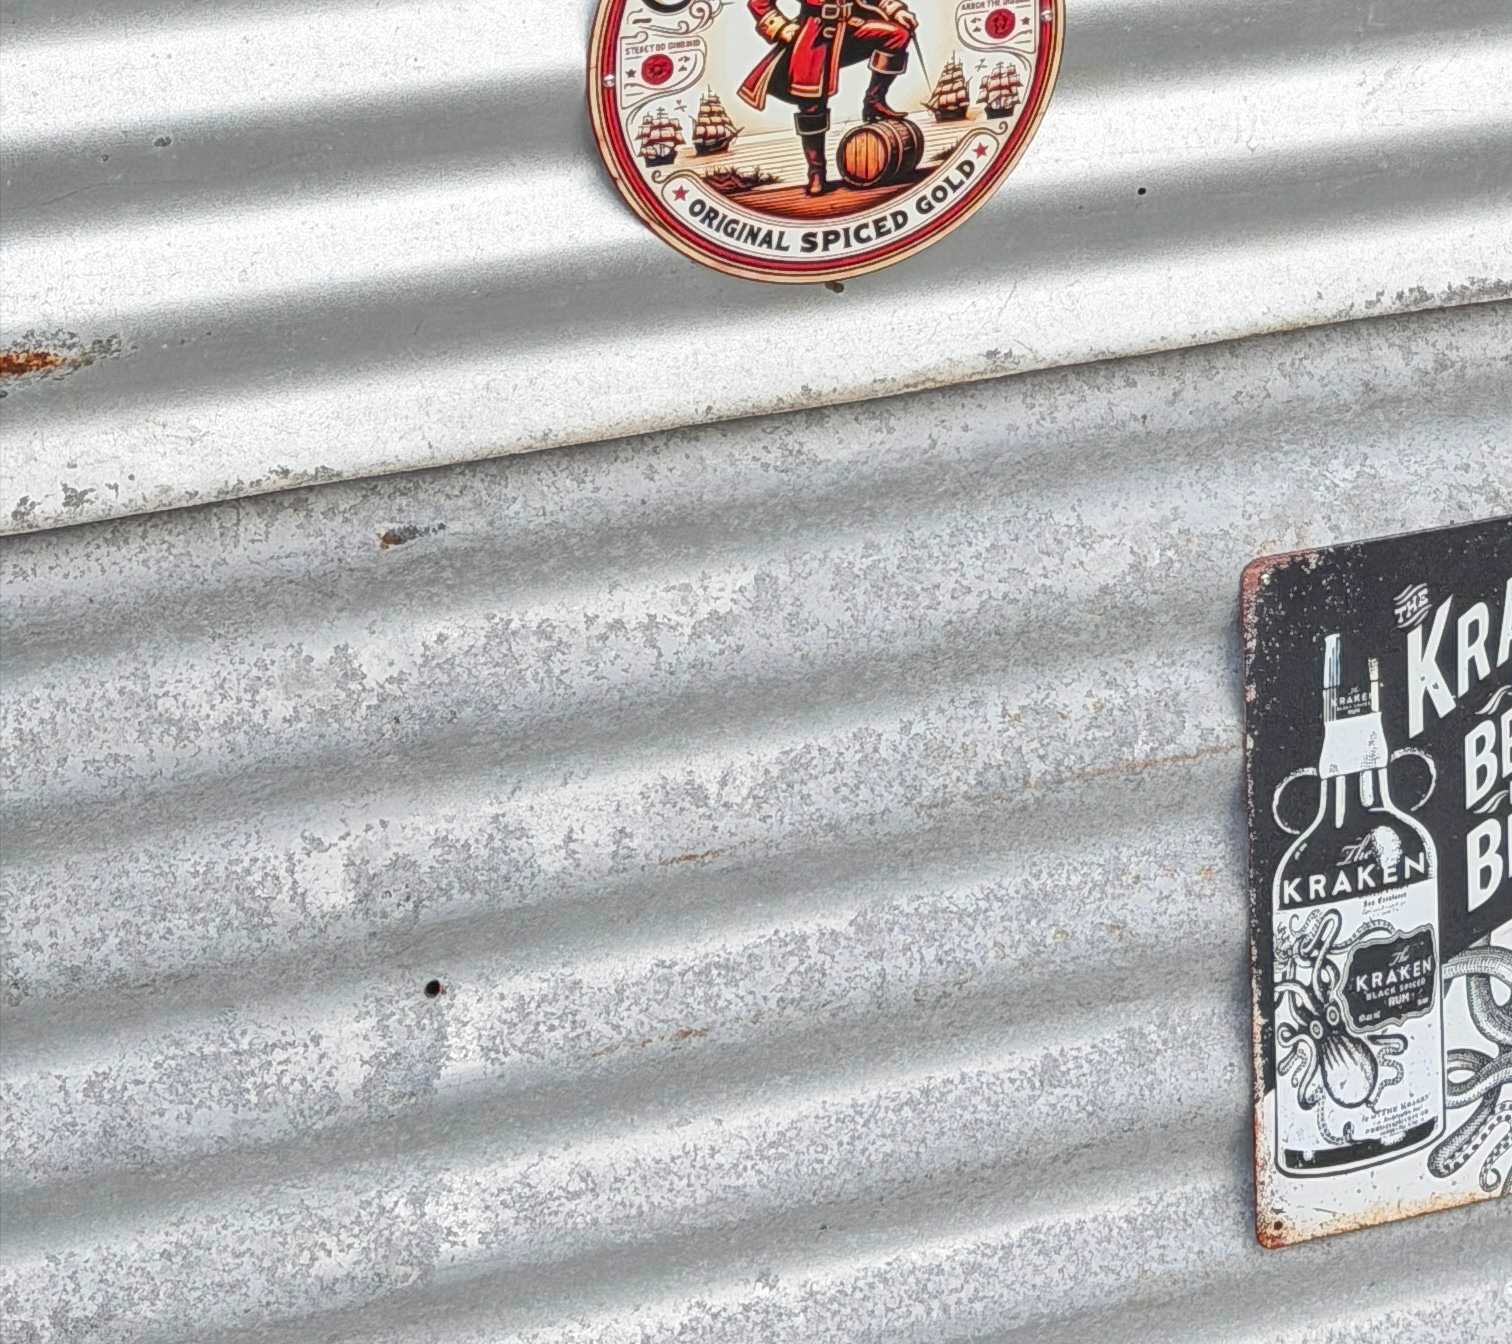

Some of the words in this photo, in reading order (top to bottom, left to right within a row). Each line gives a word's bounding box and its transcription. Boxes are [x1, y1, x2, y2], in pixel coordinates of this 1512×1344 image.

[687, 198, 791, 252] ORIGINAL
[800, 210, 909, 253] SPICED
[914, 159, 977, 215] GOLD
[1281, 851, 1427, 904] KRAKEN
[1356, 955, 1433, 992] KRAKEN
[1388, 993, 1410, 1007] RUM
